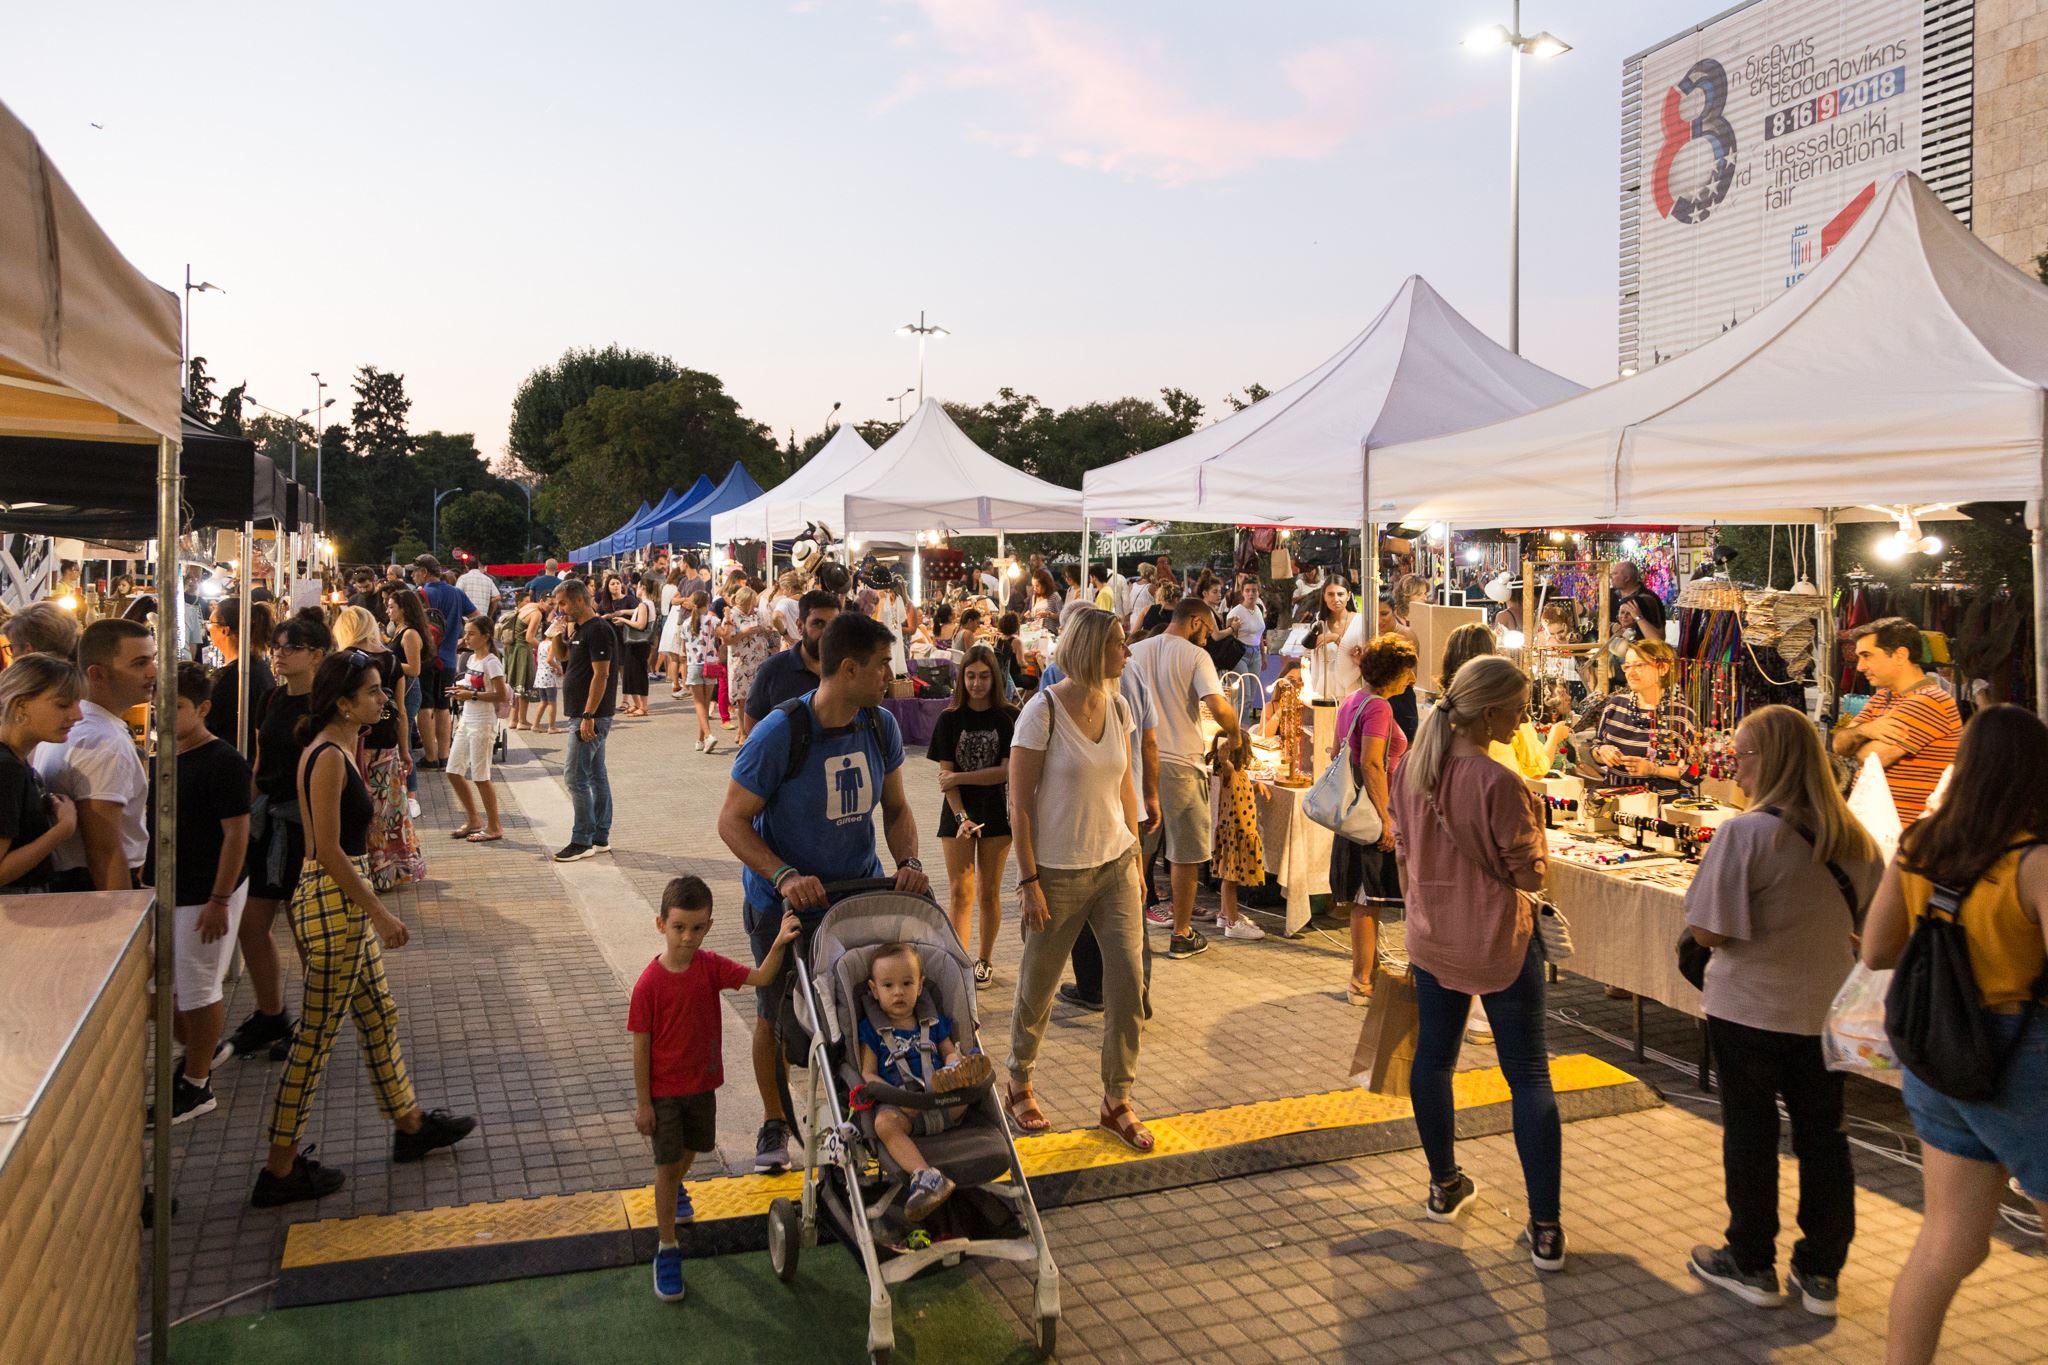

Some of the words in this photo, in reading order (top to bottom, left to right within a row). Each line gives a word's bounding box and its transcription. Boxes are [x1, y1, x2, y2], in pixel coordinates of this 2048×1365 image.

[1820, 93, 1836, 121] 9
[1840, 71, 1896, 113] 2018
[1764, 107, 1887, 171] thessaloniki
[1775, 122, 1905, 188] international
[1735, 163, 1751, 188] rd
[1764, 182, 1796, 212] fair
[836, 815, 863, 827] Gifted
